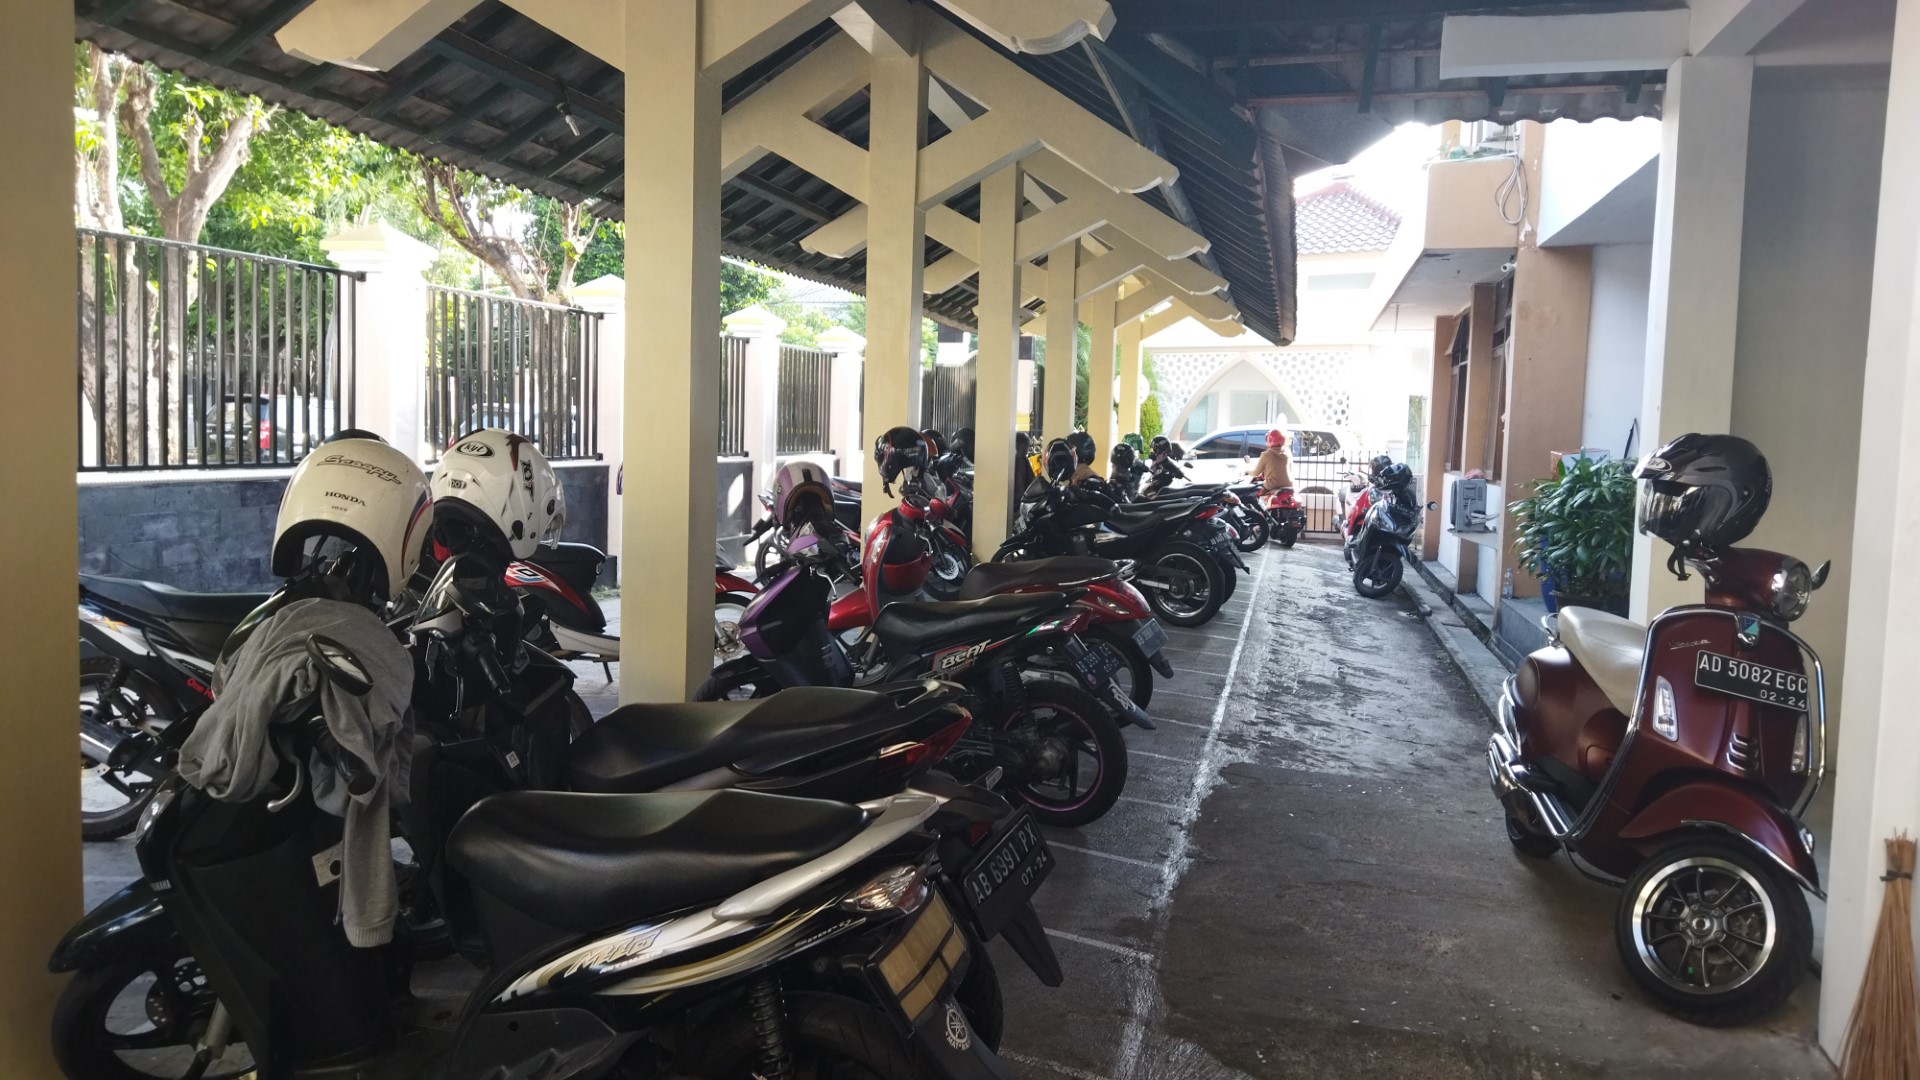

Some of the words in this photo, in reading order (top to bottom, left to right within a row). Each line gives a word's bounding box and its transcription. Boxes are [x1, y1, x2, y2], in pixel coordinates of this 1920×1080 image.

[324, 491, 366, 507] HONDA
[187, 678, 205, 693] One
[1699, 654, 1722, 673] AD
[1728, 660, 1772, 686] 5082
[1776, 672, 1808, 694] EGC
[972, 872, 992, 904] AB
[990, 841, 1021, 884] 6991
[1018, 822, 1037, 853] PX
